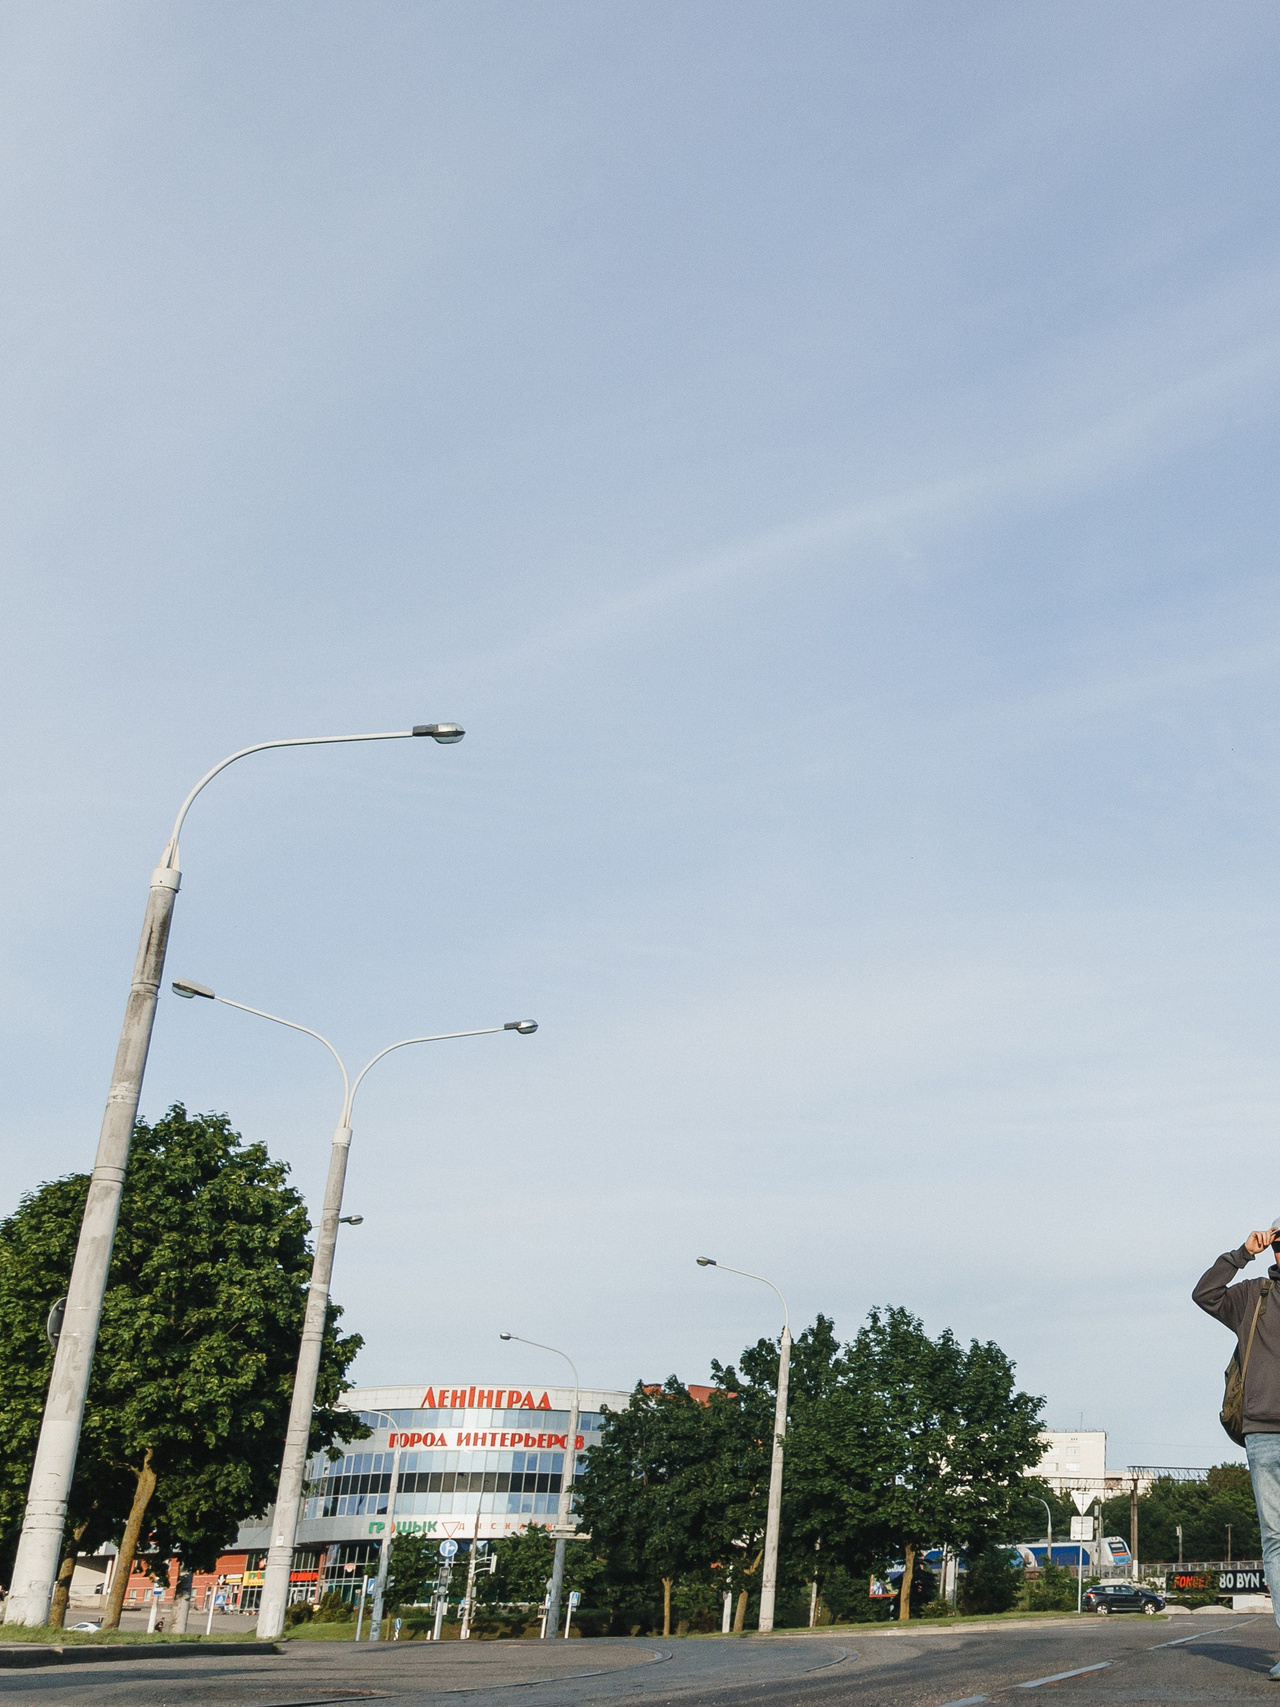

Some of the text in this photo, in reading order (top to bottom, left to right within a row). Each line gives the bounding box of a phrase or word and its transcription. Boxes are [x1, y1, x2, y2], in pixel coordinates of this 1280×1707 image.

[389, 1432, 585, 1450] ГОРОД ИНТЕРЬЕРОВ
[1219, 1572, 1234, 1589] 80
[1236, 1572, 1260, 1589] BYN
